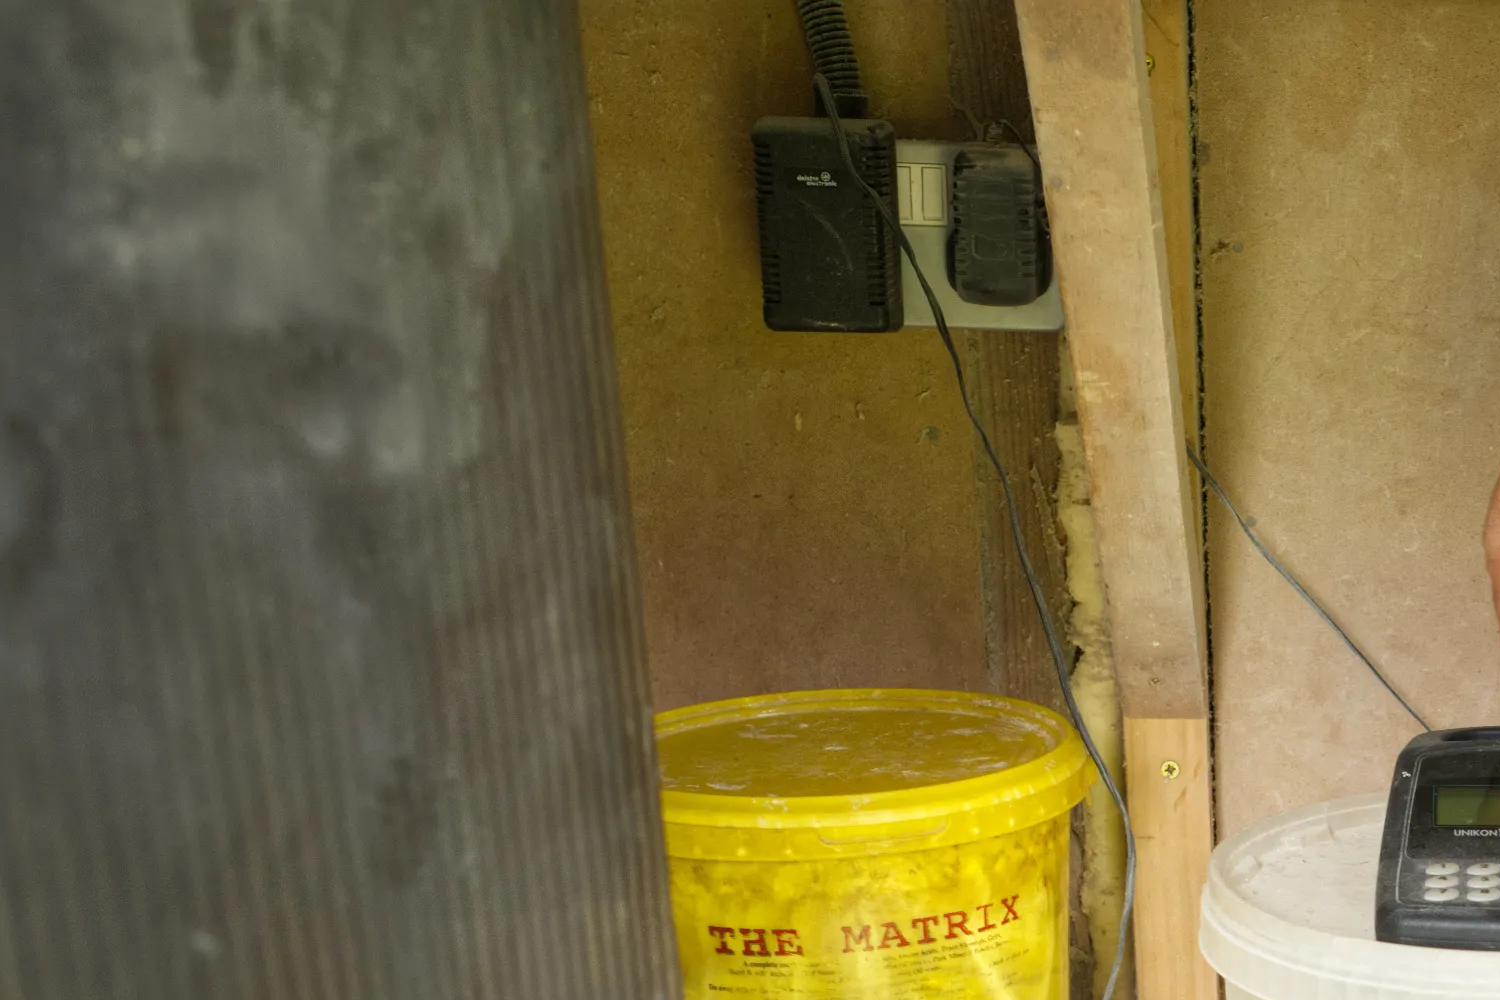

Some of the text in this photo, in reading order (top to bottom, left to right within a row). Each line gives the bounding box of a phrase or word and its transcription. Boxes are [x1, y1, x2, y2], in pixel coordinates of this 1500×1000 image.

[1453, 829, 1498, 837] UNIKON
[707, 894, 1021, 957] THE MATRIX
